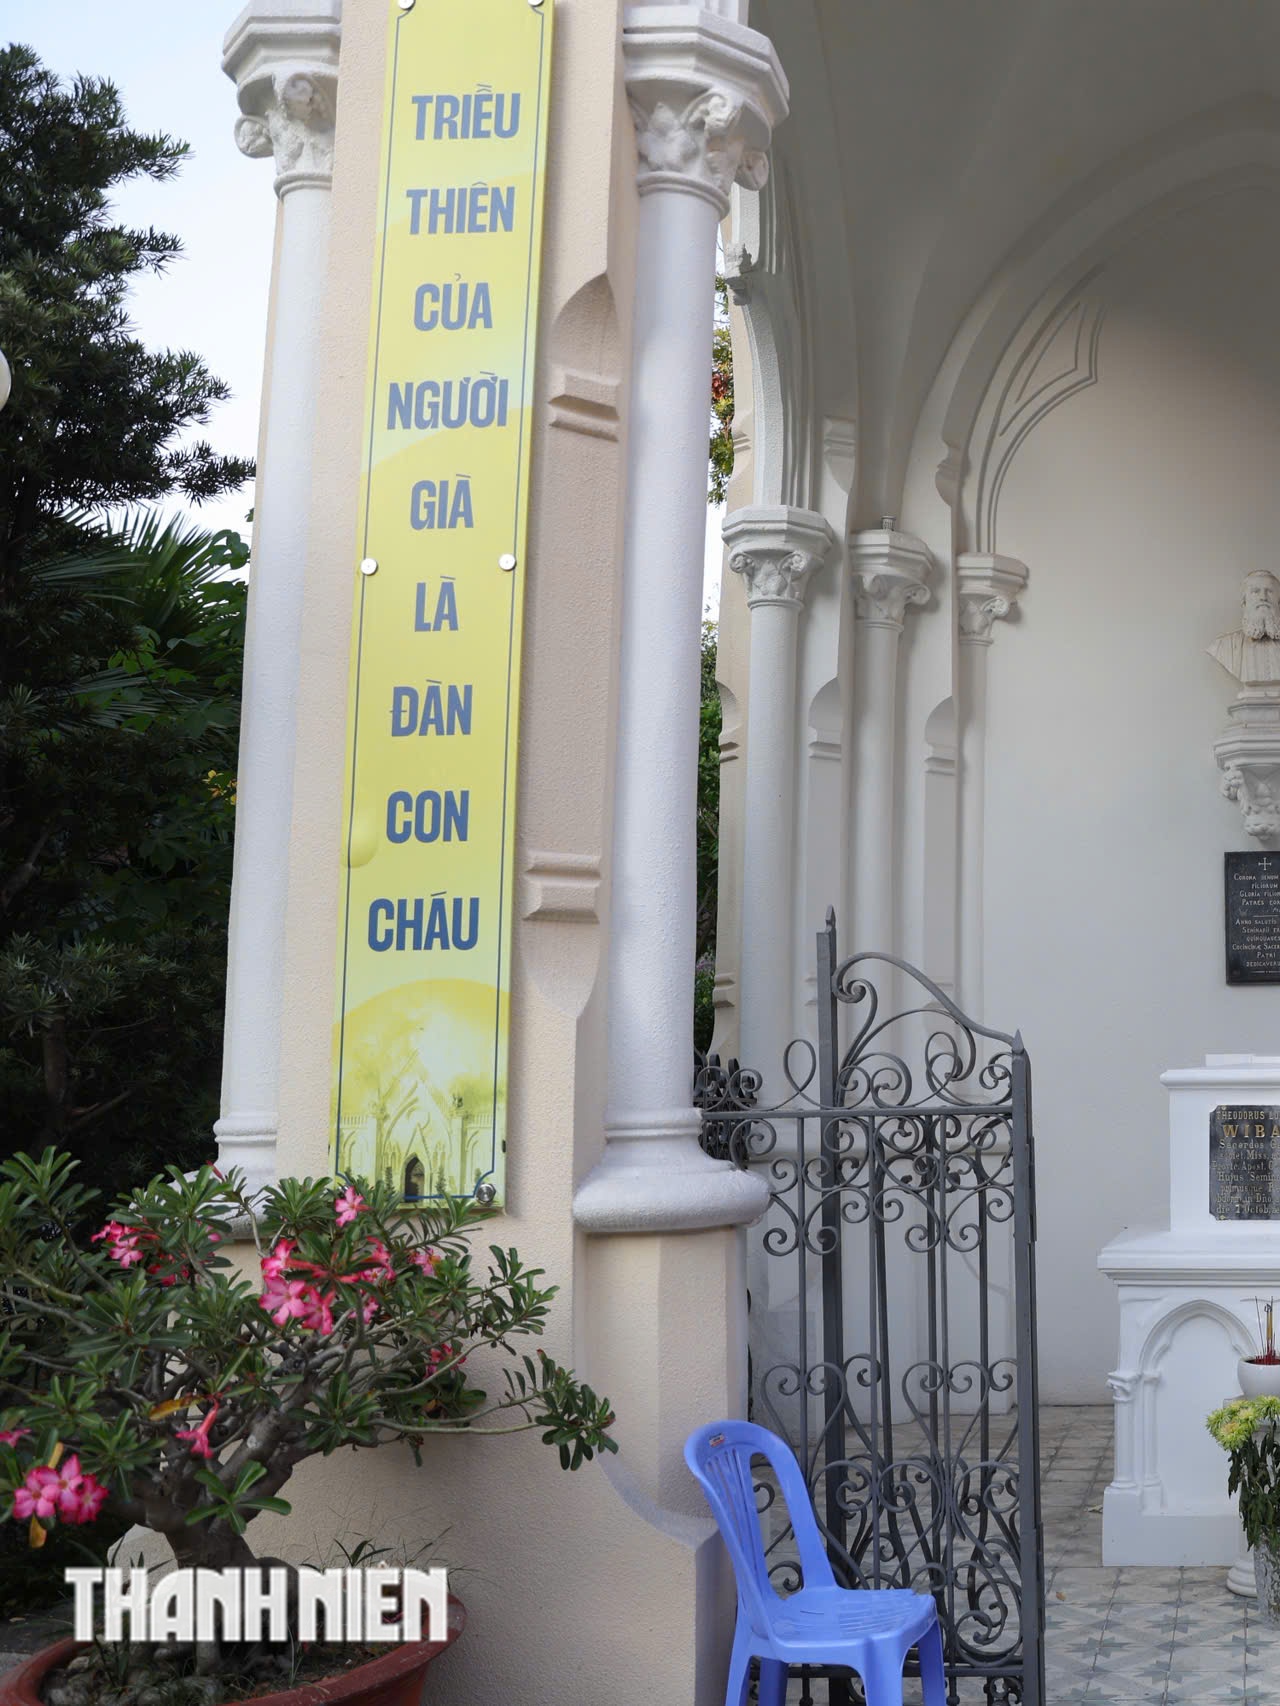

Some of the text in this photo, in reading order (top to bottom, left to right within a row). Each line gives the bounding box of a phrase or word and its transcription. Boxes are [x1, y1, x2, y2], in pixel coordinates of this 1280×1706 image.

[412, 84, 521, 140] TRIỀU
[406, 182, 515, 235] THIÊN
[413, 273, 493, 331] CỦA
[387, 371, 509, 430] NGƯỜI
[410, 474, 474, 530] GIÀ
[414, 576, 459, 632] LÀ
[390, 680, 473, 737] ĐÀN
[386, 790, 469, 844] CON
[367, 891, 480, 952] CHÁU
